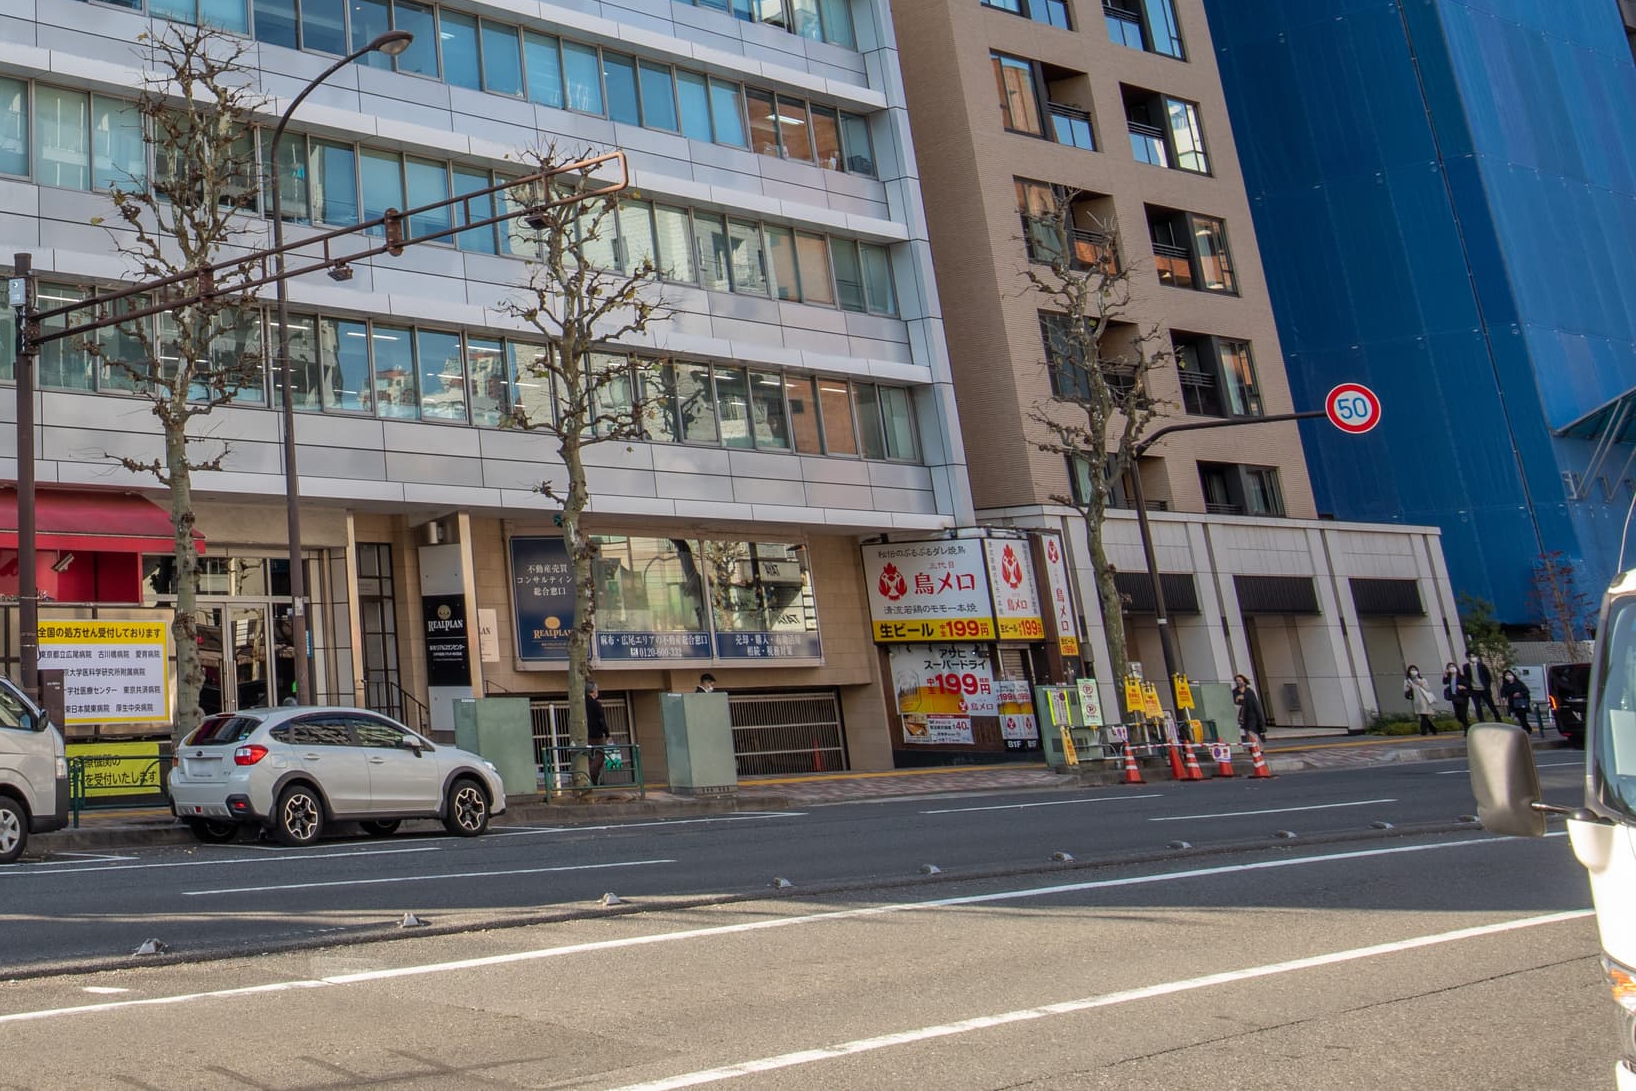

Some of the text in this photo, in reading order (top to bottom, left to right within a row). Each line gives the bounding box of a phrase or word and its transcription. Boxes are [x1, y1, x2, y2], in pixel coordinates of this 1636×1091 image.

[1337, 397, 1368, 419] 50
[528, 564, 568, 574] 不動産売買
[914, 572, 975, 594] 鳥メロ
[533, 587, 566, 596] 総合窓口
[1007, 598, 1027, 611] 鳥メロ
[1056, 588, 1069, 632] 鳥メロ
[427, 619, 464, 632] REALPLAN
[880, 623, 934, 638] 生ビール
[38, 627, 161, 638] 全国の処方せん受付しております
[940, 649, 967, 658] アサヒ
[924, 660, 987, 670] スーパードライ
[971, 703, 993, 711] 鳥メロ
